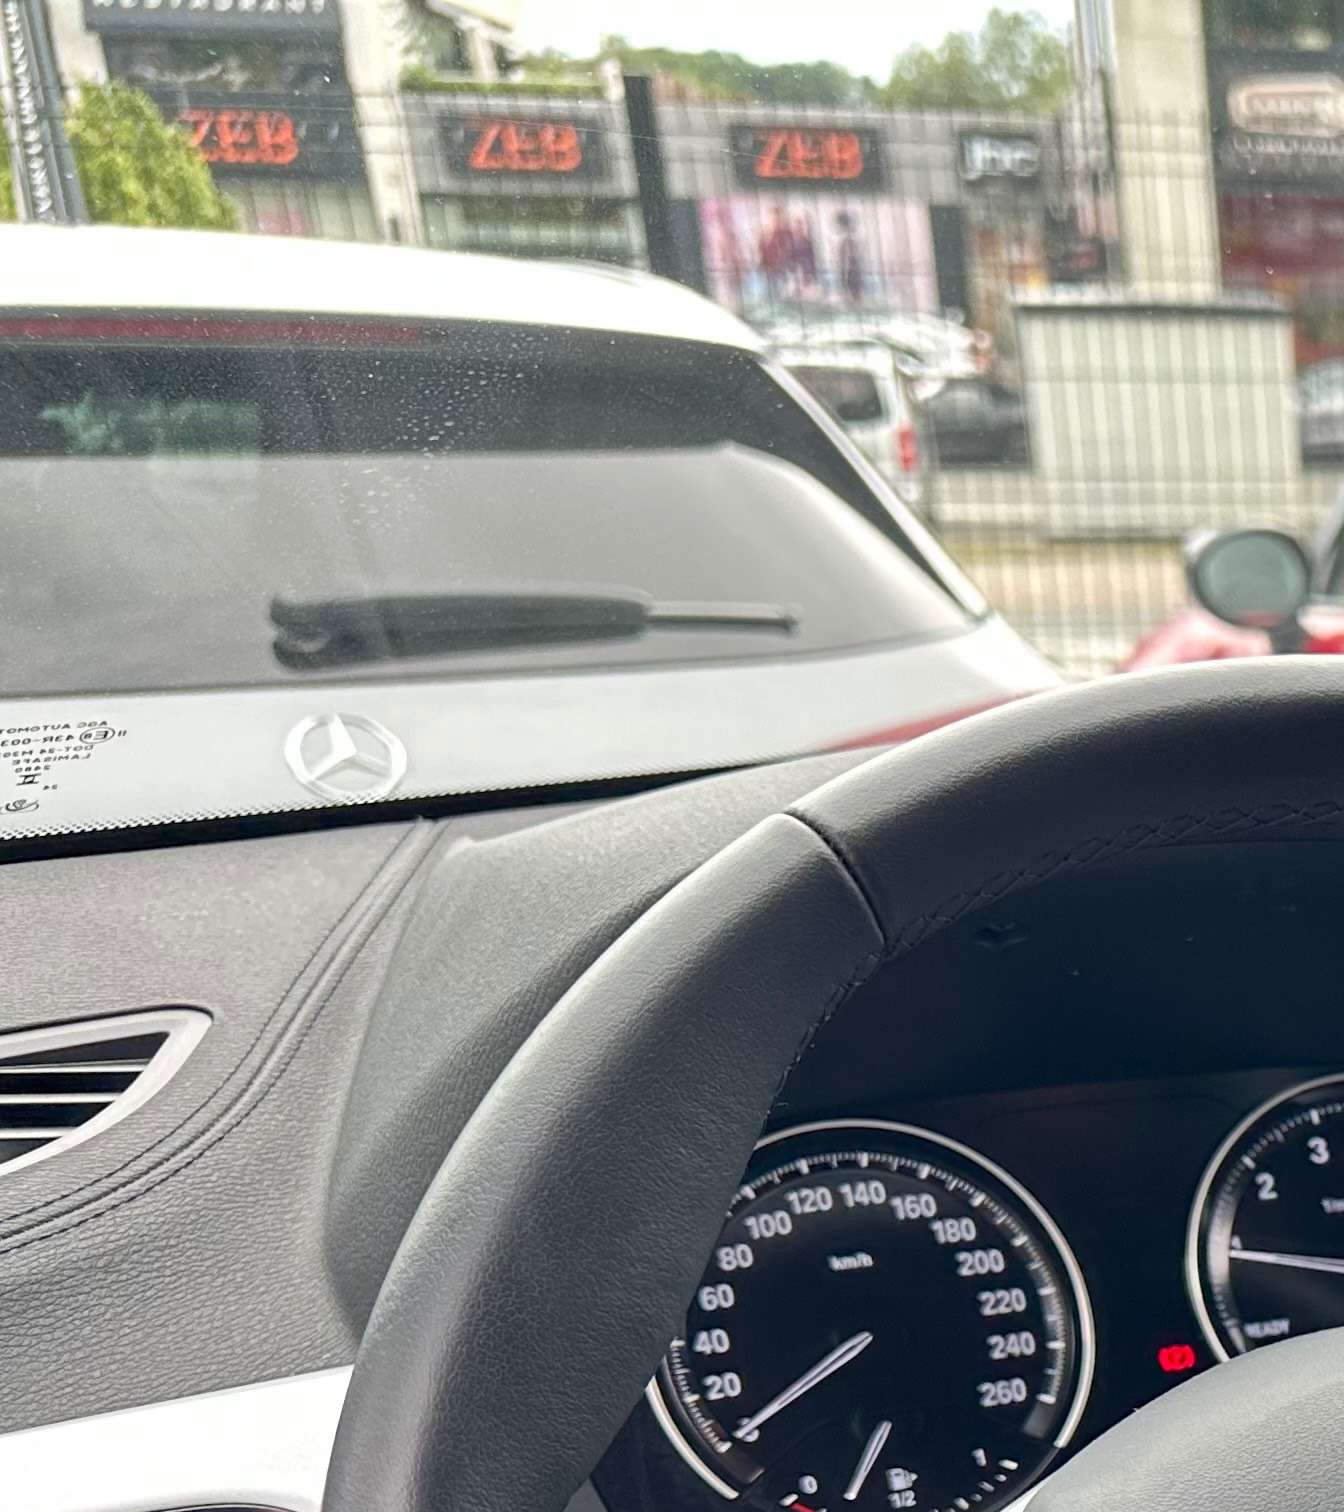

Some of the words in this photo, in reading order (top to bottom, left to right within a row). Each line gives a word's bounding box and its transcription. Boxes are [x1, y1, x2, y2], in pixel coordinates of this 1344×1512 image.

[466, 120, 582, 171] ZEB
[754, 129, 864, 179] ZEB
[1307, 1137, 1331, 1165] 3
[785, 1186, 833, 1215] 120
[839, 1180, 886, 1208] 140
[1255, 1172, 1278, 1201] 2
[890, 1193, 937, 1220] 160
[745, 1210, 792, 1240] 100
[931, 1217, 977, 1243] 180
[717, 1244, 753, 1270] 80
[827, 1251, 873, 1272] km/h
[955, 1249, 1004, 1276] 200
[700, 1283, 735, 1311] 60
[978, 1287, 1026, 1316] 220
[693, 1328, 730, 1355] 40
[988, 1331, 1036, 1360] 240
[704, 1372, 741, 1399] 20
[977, 1378, 1027, 1407] 260
